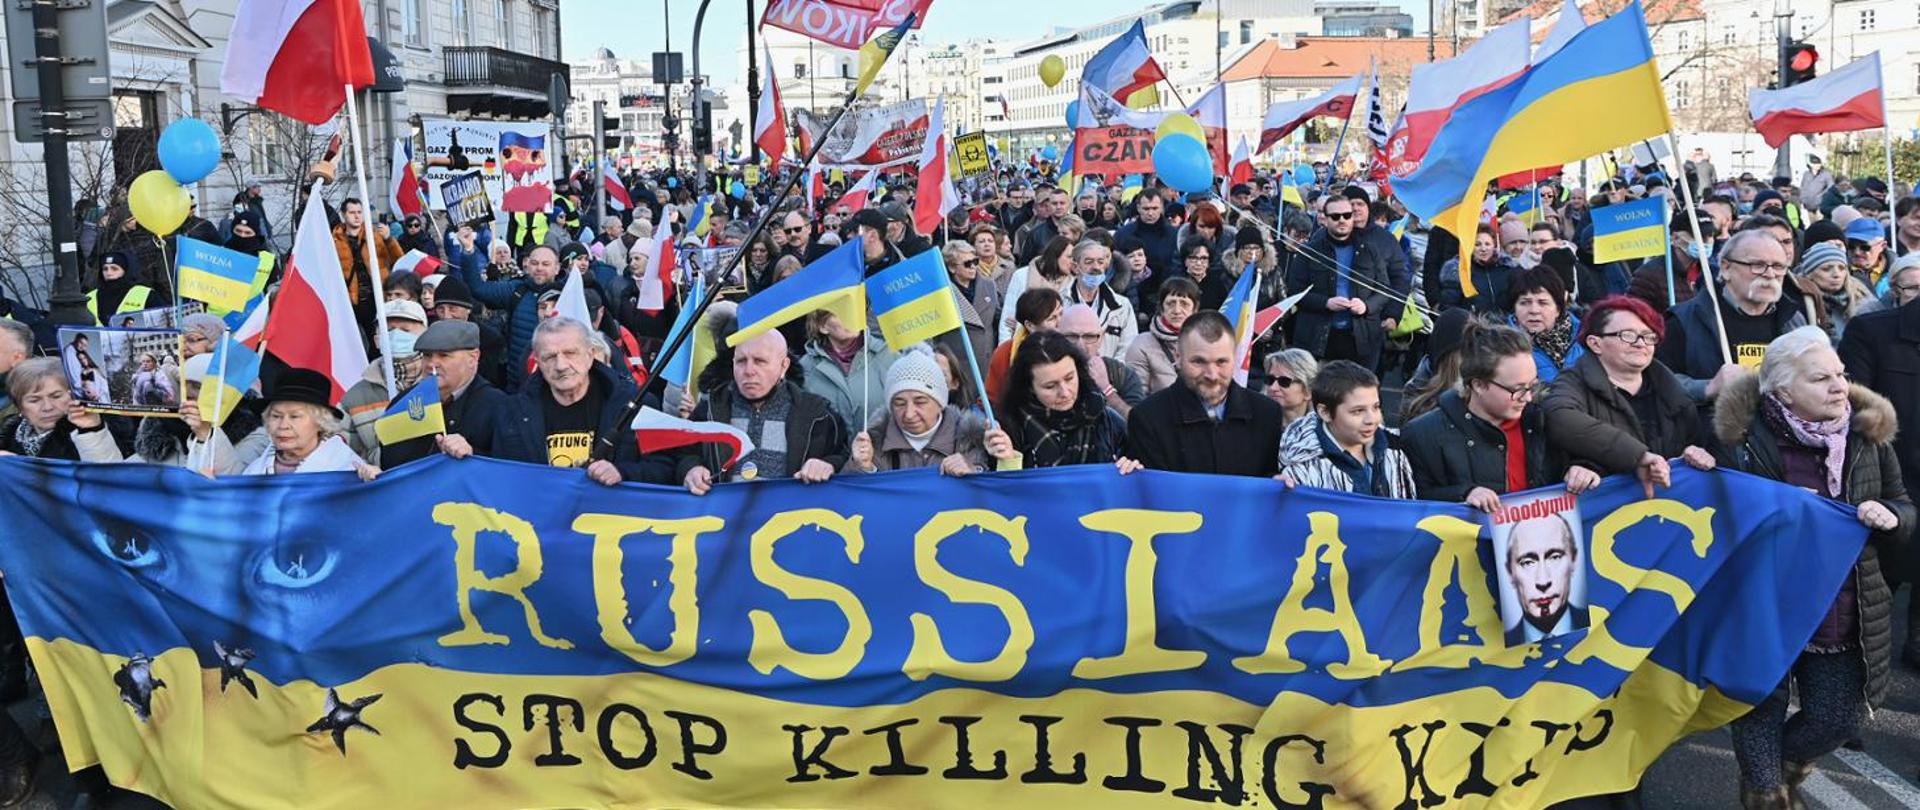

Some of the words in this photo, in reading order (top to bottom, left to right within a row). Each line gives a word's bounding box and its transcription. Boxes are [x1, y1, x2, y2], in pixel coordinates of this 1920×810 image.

[427, 146, 447, 154] GAZ
[465, 147, 494, 155] PROM
[1083, 139, 1154, 162] CZAN
[1614, 207, 1652, 222] WOLNA
[883, 272, 921, 294] WOLNA
[1739, 346, 1766, 357] ACHT
[547, 436, 588, 449] CHTUNG
[432, 498, 1716, 682] RUSSIANS
[453, 692, 728, 780] STOP
[782, 716, 1336, 810] KILLING
